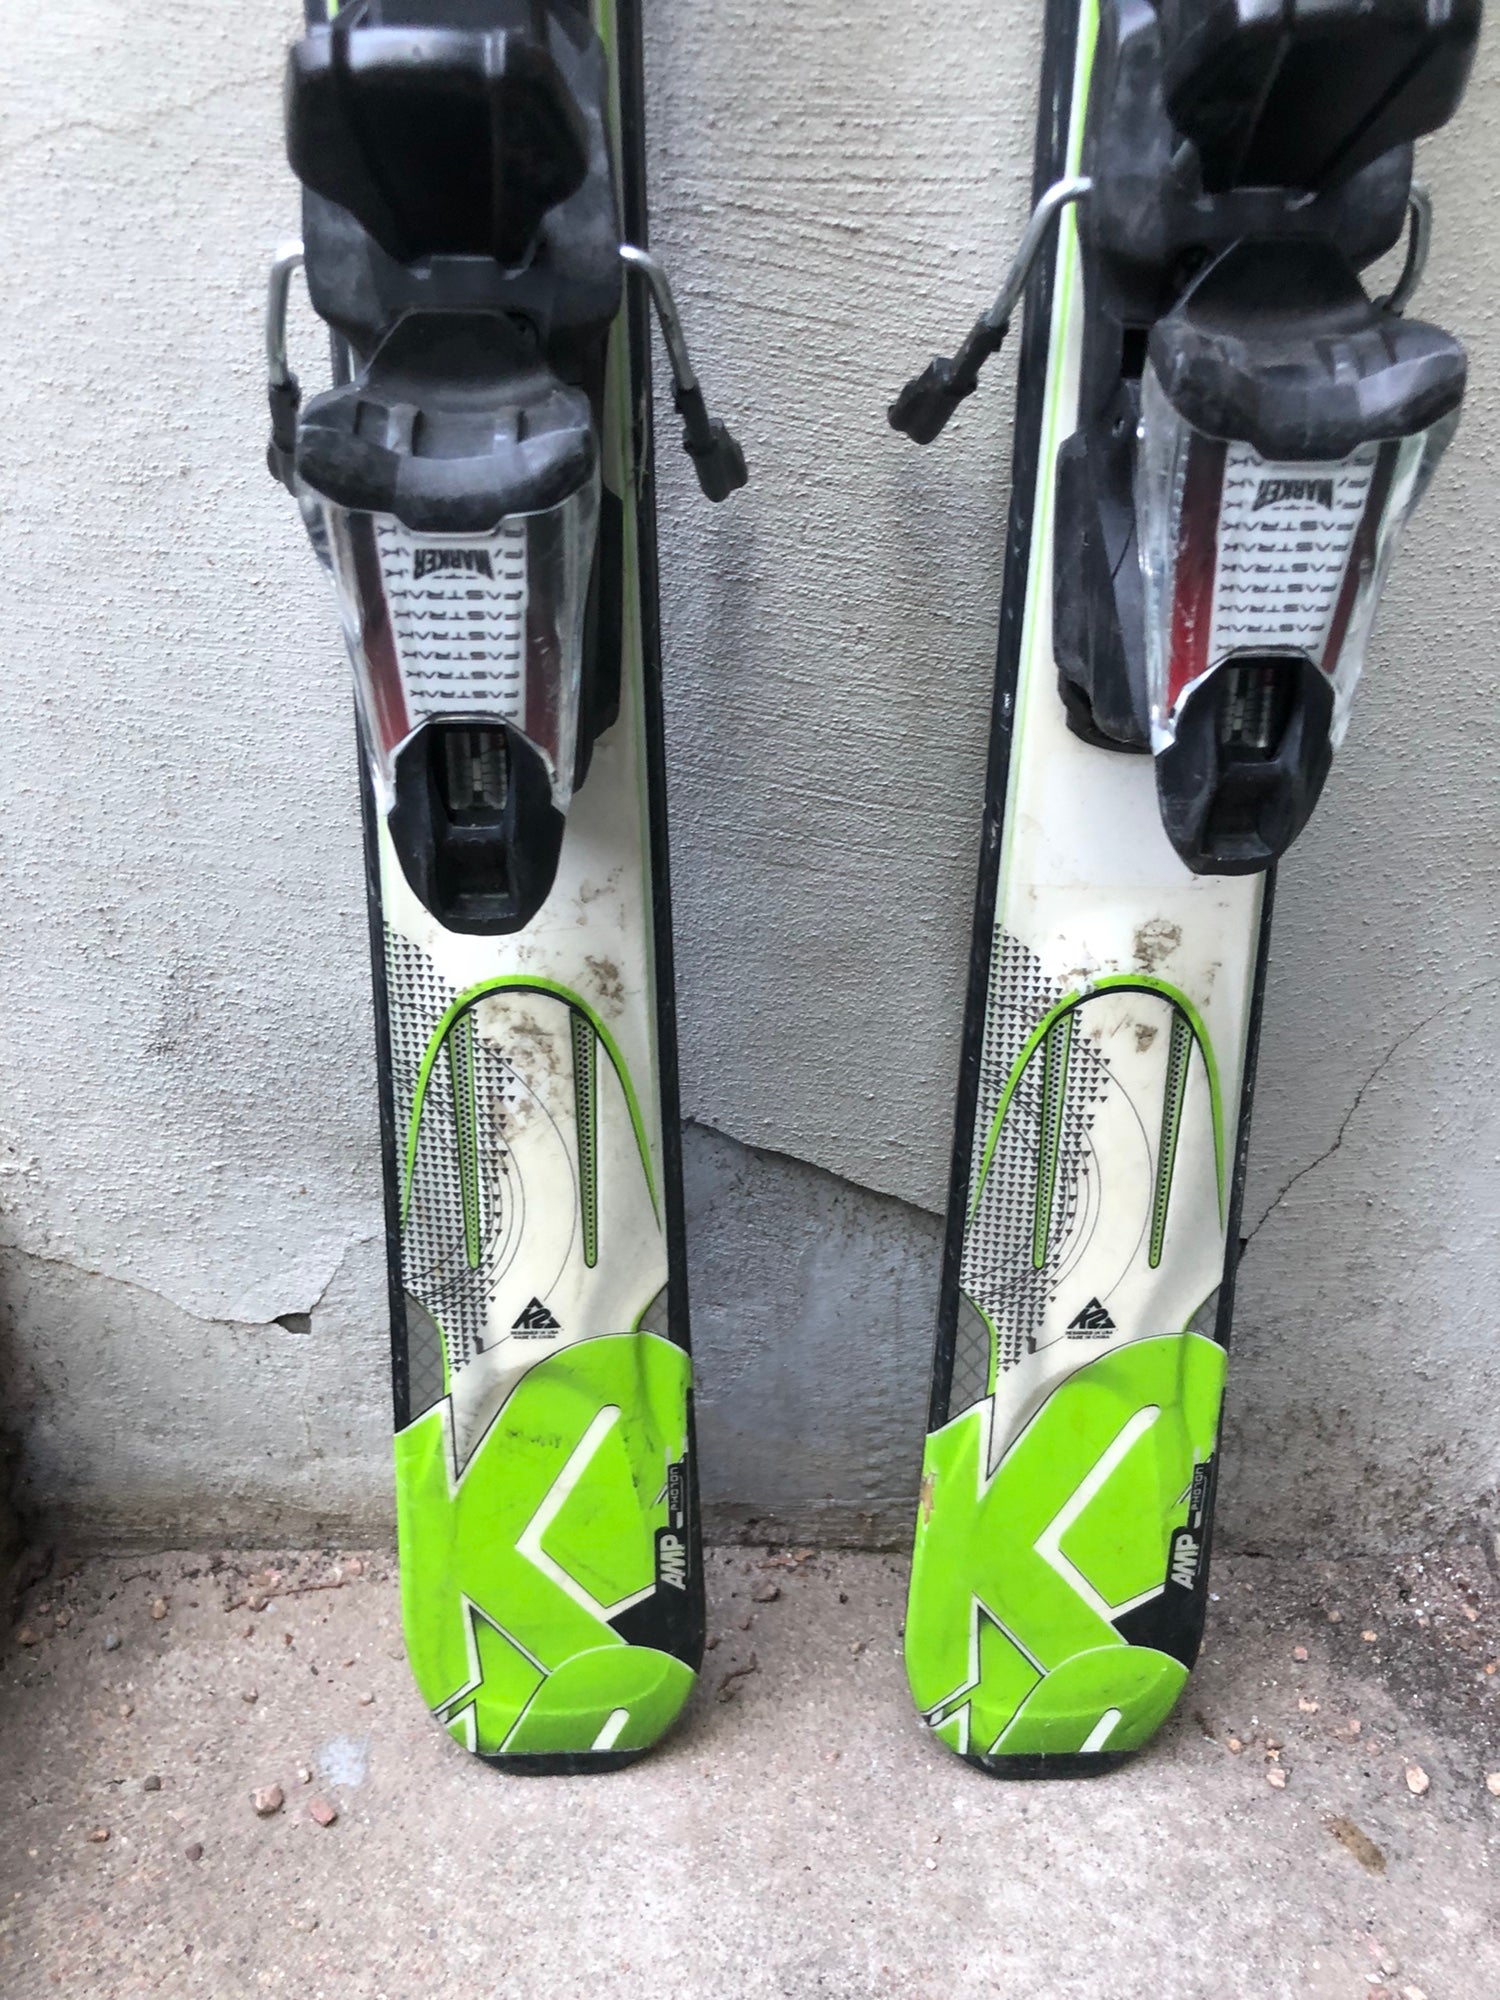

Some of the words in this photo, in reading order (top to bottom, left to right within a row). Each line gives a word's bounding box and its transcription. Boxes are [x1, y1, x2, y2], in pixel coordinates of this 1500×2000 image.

[1252, 479, 1334, 511] MARKER
[1221, 521, 1354, 531] FASTRAK
[1223, 542, 1350, 552] FASTRAK
[413, 549, 495, 580] MARKER
[1221, 563, 1343, 573] FASTRAK
[1219, 584, 1338, 593] FASTRAK
[390, 590, 523, 600] FASTRAK
[1218, 604, 1331, 613] FASTRAK
[394, 611, 521, 620] FASTRAK
[1216, 624, 1325, 633] FASTRAK
[398, 631, 520, 640] FASTRAK
[402, 651, 520, 660] FASTRAK
[406, 671, 520, 679] FASTRAK
[410, 690, 519, 699] FASTRAK
[511, 1307, 553, 1329] K2
[1067, 1307, 1109, 1329] K2
[660, 1534, 686, 1591] AMP
[1170, 1533, 1200, 1591] AMP
